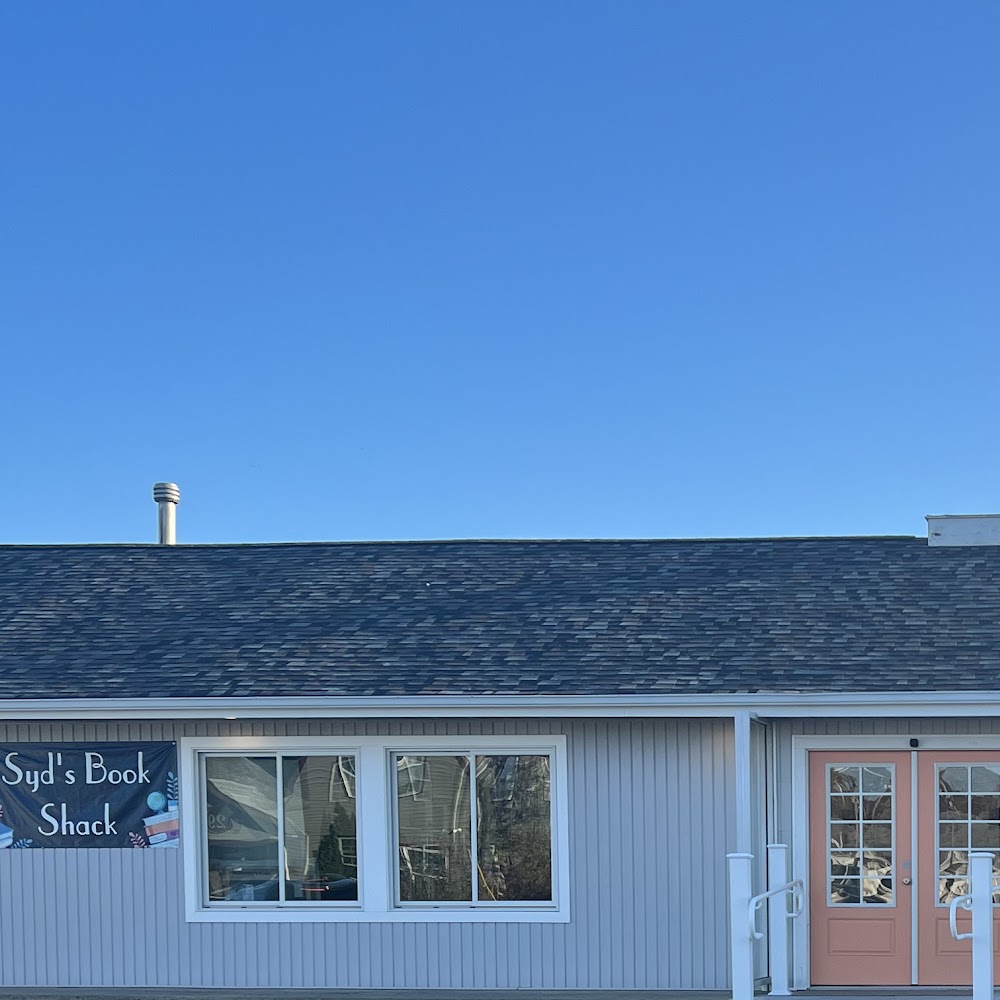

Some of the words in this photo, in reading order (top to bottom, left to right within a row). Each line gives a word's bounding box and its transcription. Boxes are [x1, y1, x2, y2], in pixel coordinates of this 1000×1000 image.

[2, 752, 76, 793] Syd's
[85, 751, 151, 785] Book
[38, 803, 118, 836] Shack
